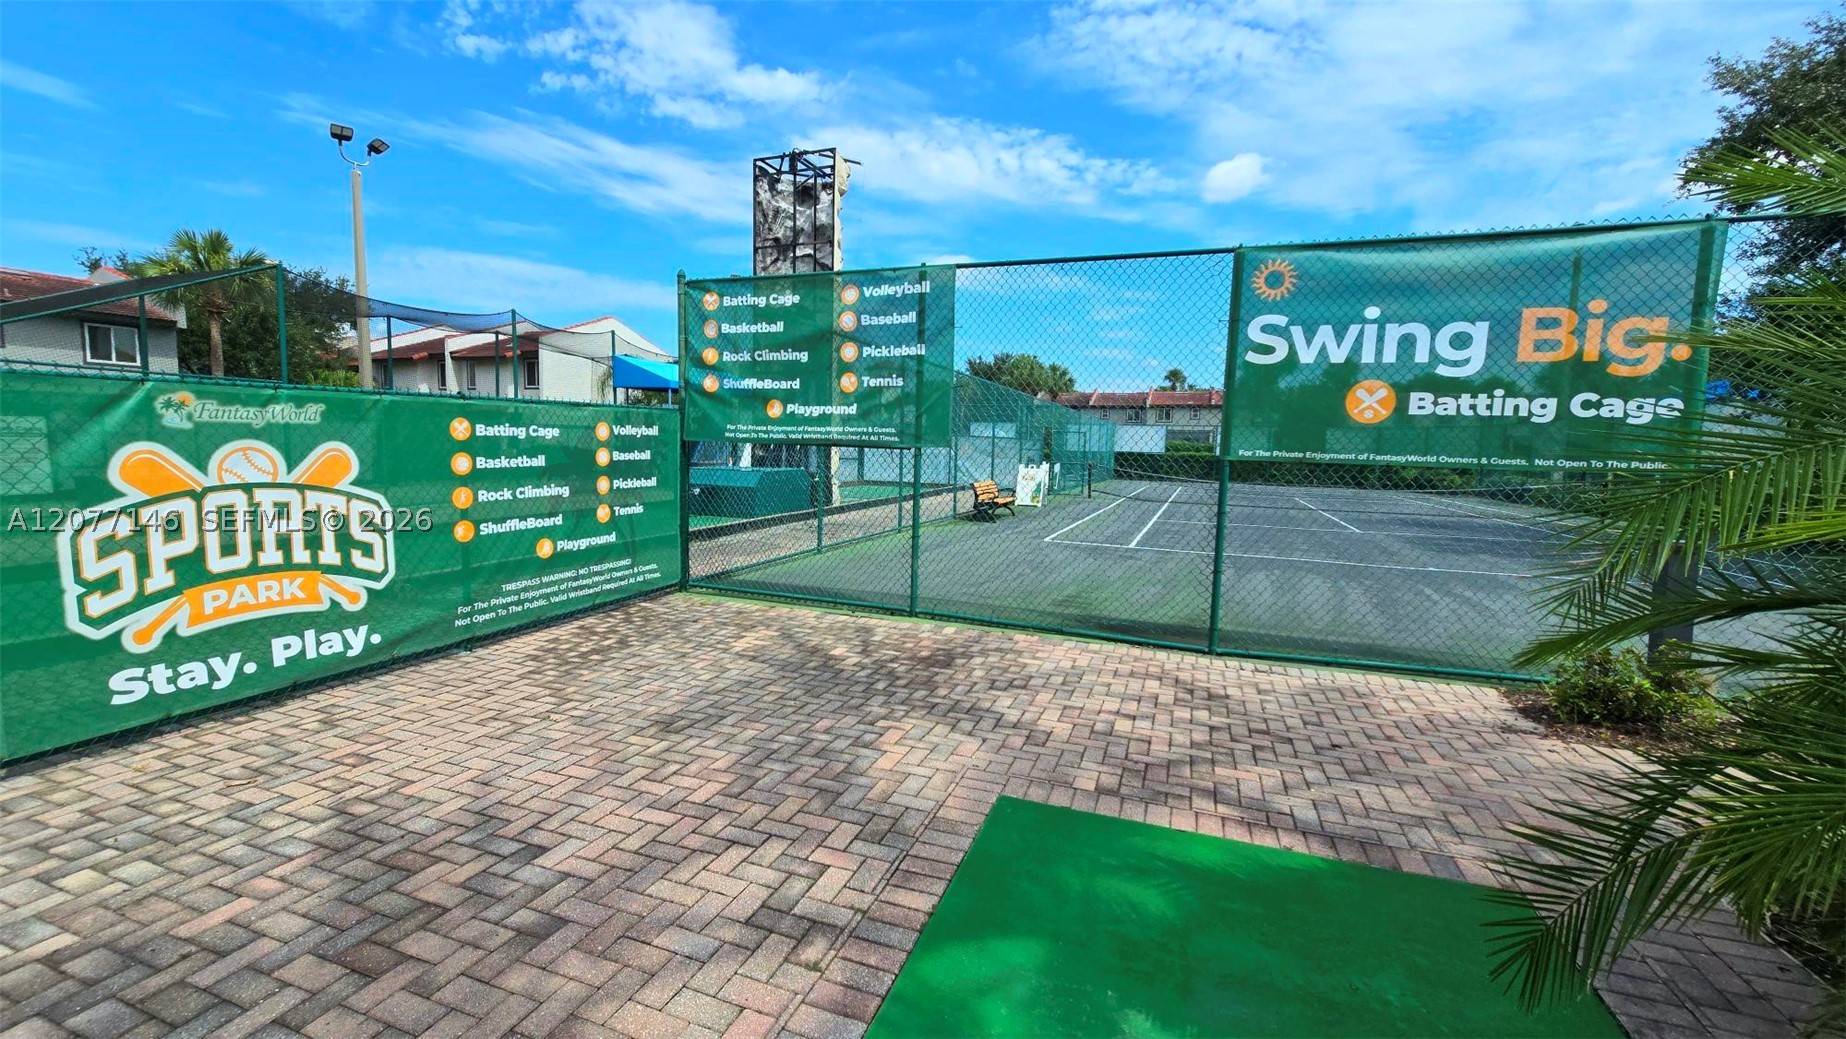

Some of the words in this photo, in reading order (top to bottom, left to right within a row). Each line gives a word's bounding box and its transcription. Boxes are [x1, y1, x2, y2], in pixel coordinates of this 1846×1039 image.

[862, 281, 930, 298] Volleyball
[723, 294, 766, 308] Batting
[769, 294, 800, 306] Cage
[860, 312, 916, 326] Baseball
[722, 321, 784, 334] Basketball
[1244, 306, 1490, 378] Swing
[1517, 298, 1692, 377] Big.
[723, 351, 752, 362] Rock
[754, 349, 808, 364] Climbing
[862, 344, 925, 358] Pickleball
[723, 378, 800, 390] ShuffleBoard
[862, 374, 903, 388] Tennis
[193, 402, 322, 426] FantasyWorld
[786, 403, 857, 416] Playground
[1408, 389, 1558, 423] Batting
[1570, 392, 1684, 424] Cage
[476, 424, 526, 438] Batting
[529, 425, 560, 439] Cage
[612, 425, 658, 436] Volleyball
[476, 455, 546, 468] Basketball
[612, 450, 650, 461] Baseball
[1273, 450, 1304, 458] Private
[1306, 452, 1355, 460] Enjoyment
[1370, 454, 1437, 462] FantasyWorld
[1439, 456, 1478, 464] Owners
[1490, 457, 1528, 466] Guests.
[1556, 459, 1587, 468] Open
[1606, 460, 1628, 468] The
[613, 477, 656, 489] Pickleball
[478, 488, 512, 502] Rock
[516, 484, 570, 498] Climbing
[614, 504, 644, 516] Tennis
[480, 514, 562, 536] ShuffleBoard
[556, 532, 616, 552] Playground
[77, 488, 386, 618] SPORTS
[501, 577, 540, 592] TRESPASS
[541, 570, 578, 583] WARNING:
[578, 567, 589, 576] NO
[590, 558, 632, 572] TRESPASSING!
[203, 576, 309, 615] PARK
[458, 606, 472, 614] For
[474, 602, 489, 611] The
[490, 594, 518, 606] Private
[520, 585, 558, 600] Enjoyment
[560, 582, 568, 590] of
[568, 573, 610, 588] FantasyWorld
[612, 569, 633, 578] Owners
[638, 563, 658, 572] Guests.
[455, 617, 470, 628] Not
[472, 612, 496, 623] Open
[508, 605, 523, 614] The
[524, 599, 549, 610] Public.
[550, 592, 568, 603] Valid
[568, 584, 602, 599] Wristband
[602, 579, 628, 590] Required
[644, 572, 661, 580] Times.
[108, 652, 257, 705] Stay.
[271, 625, 382, 668] Play.
